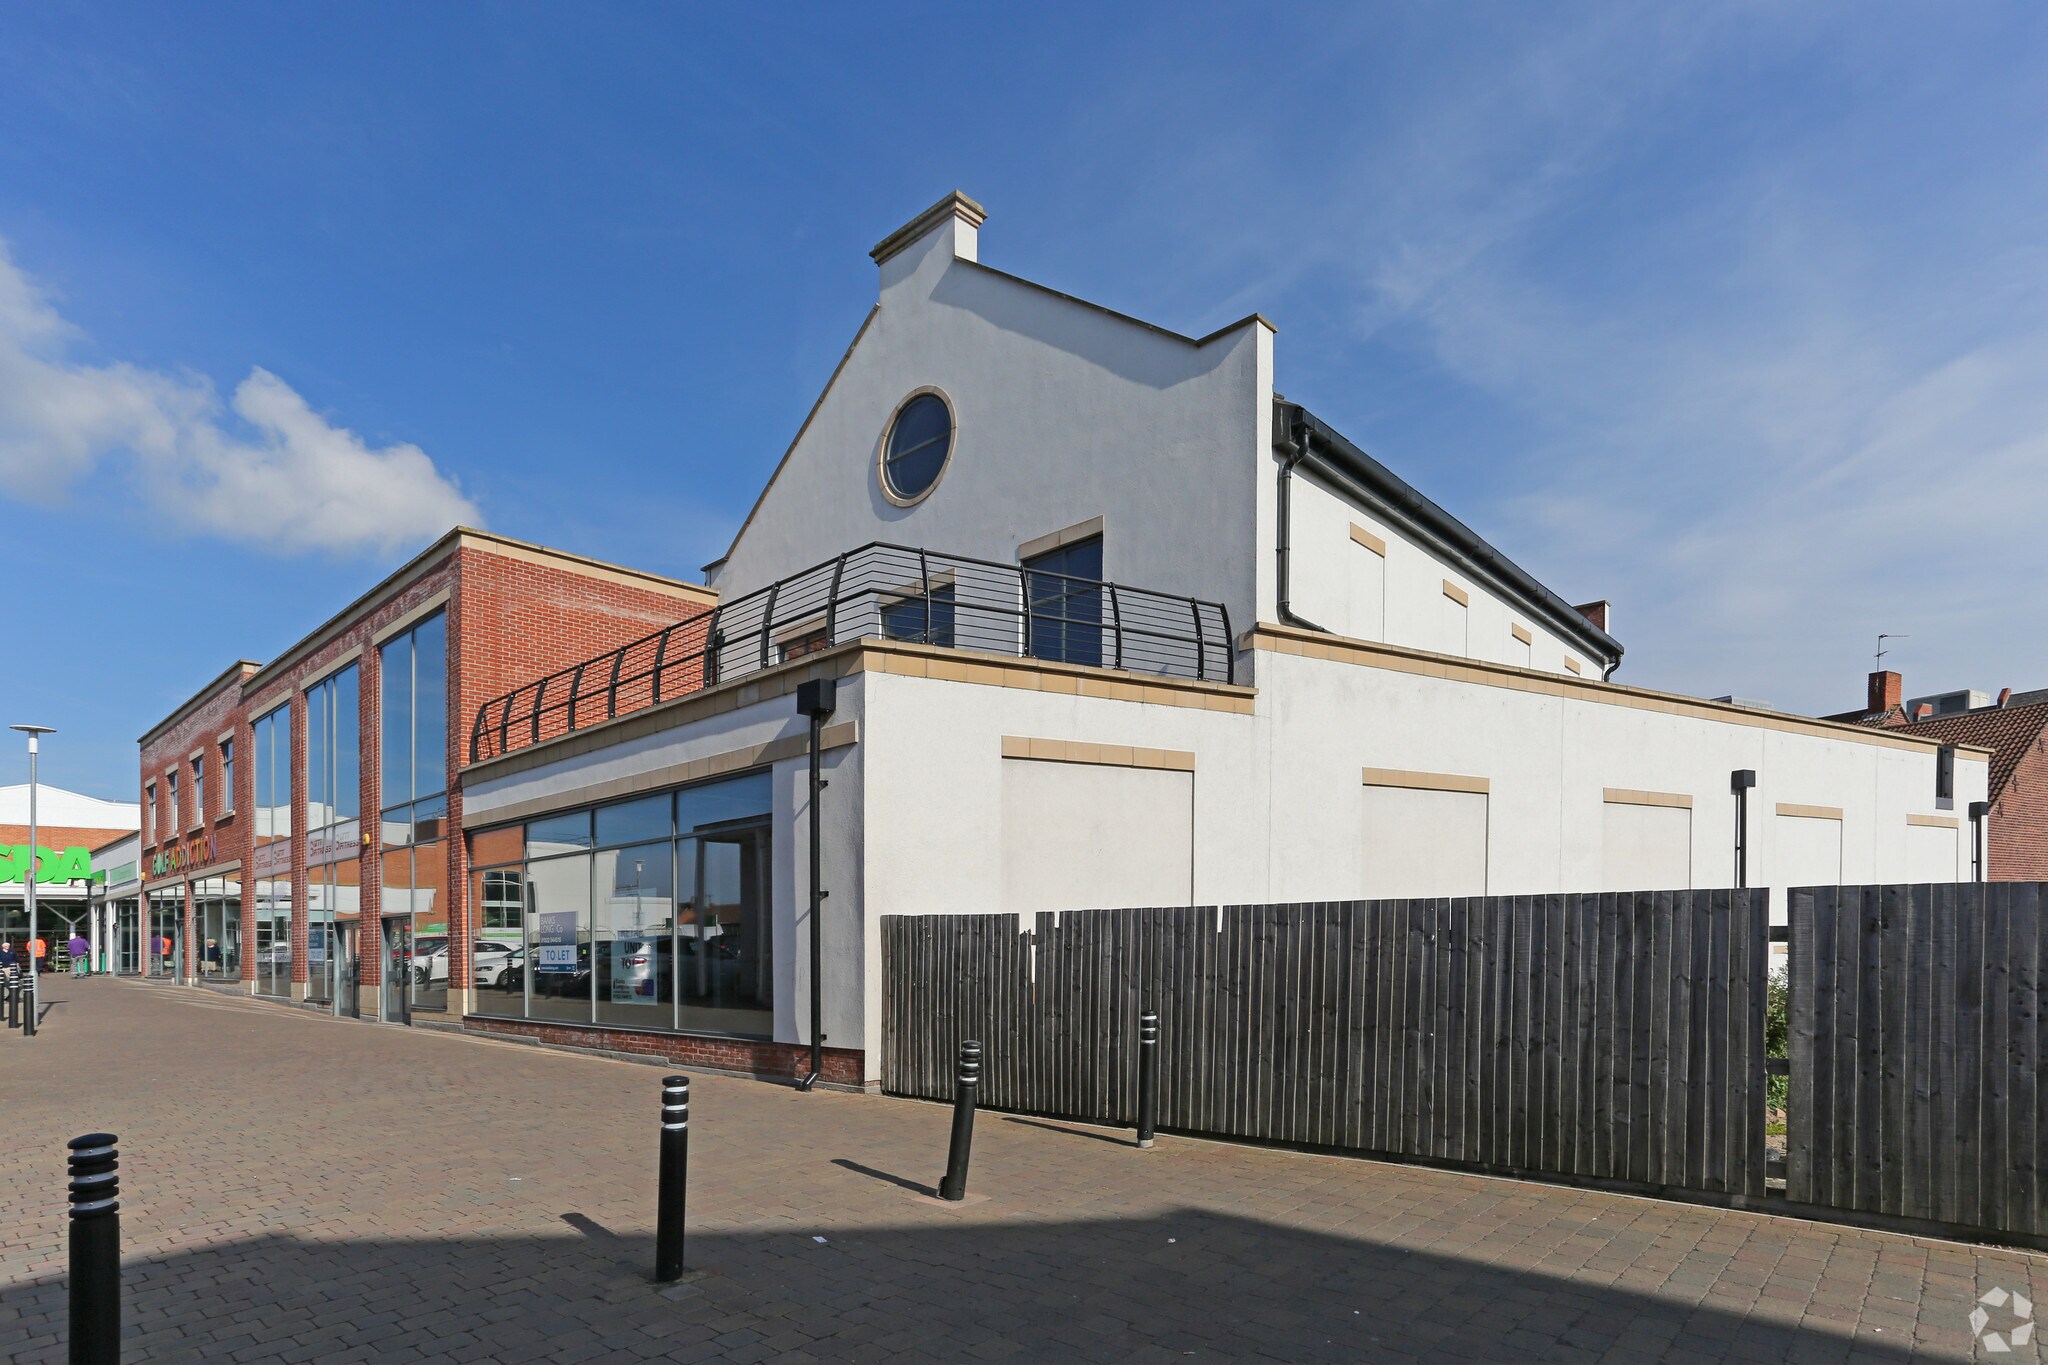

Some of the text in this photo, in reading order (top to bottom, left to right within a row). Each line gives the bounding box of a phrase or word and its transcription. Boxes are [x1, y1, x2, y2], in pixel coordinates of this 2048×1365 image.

[153, 832, 217, 876] GOLF ADDICTION
[546, 950, 570, 961] TO LET
